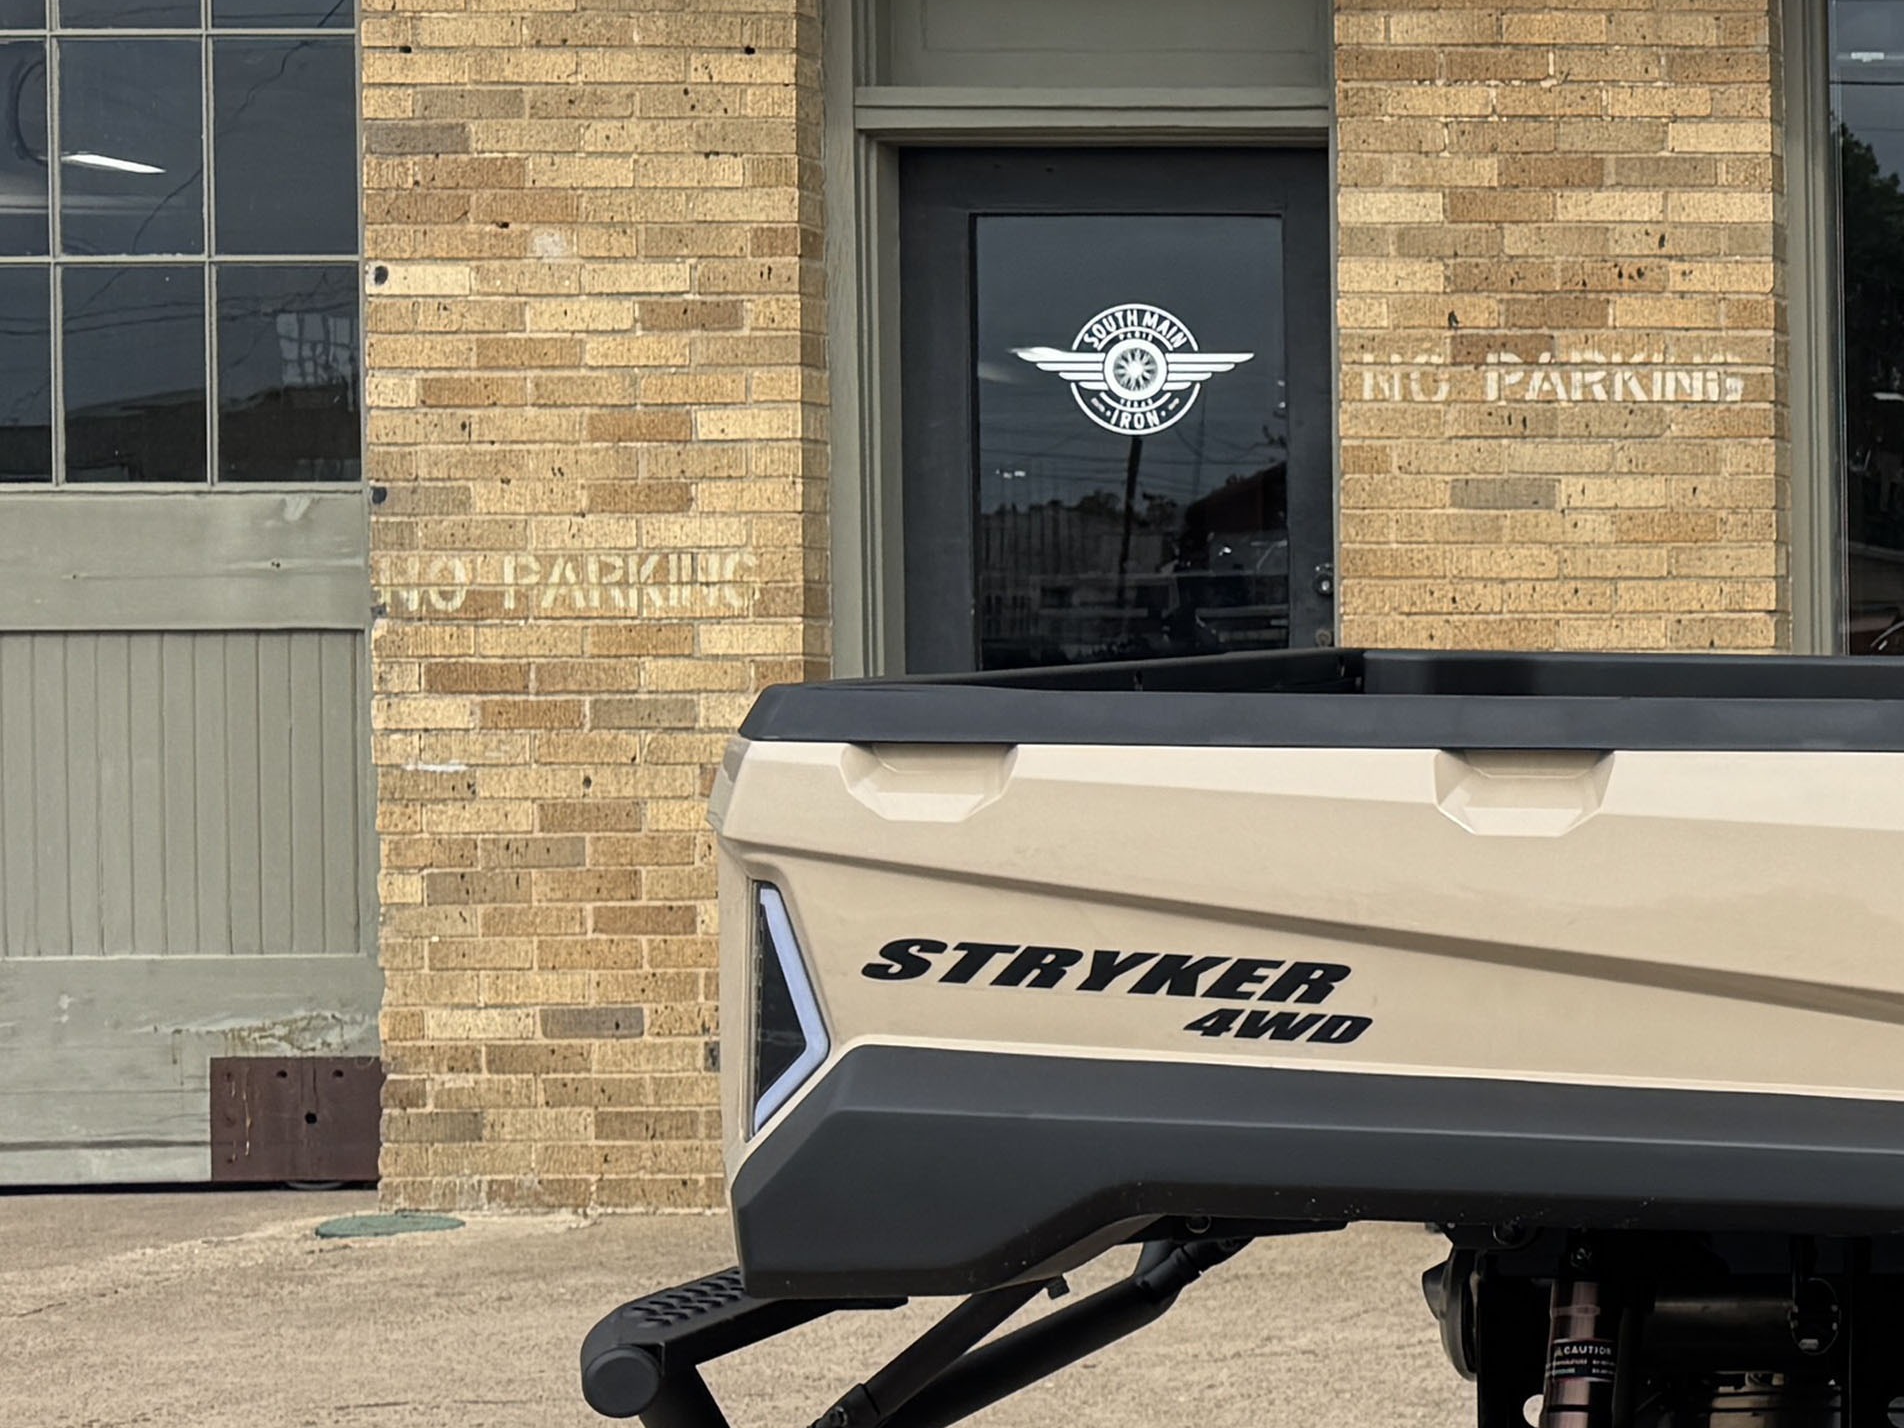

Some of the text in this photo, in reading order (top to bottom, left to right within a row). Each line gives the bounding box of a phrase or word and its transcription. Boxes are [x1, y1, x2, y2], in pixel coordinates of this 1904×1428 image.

[1083, 309, 1188, 349] SOUTH MAIN
[1361, 350, 1745, 403] NO PARKING
[1109, 408, 1160, 430] IRON
[380, 554, 467, 612] NO
[861, 937, 1352, 1006] STRYKER
[1183, 1007, 1375, 1045] 4WD
